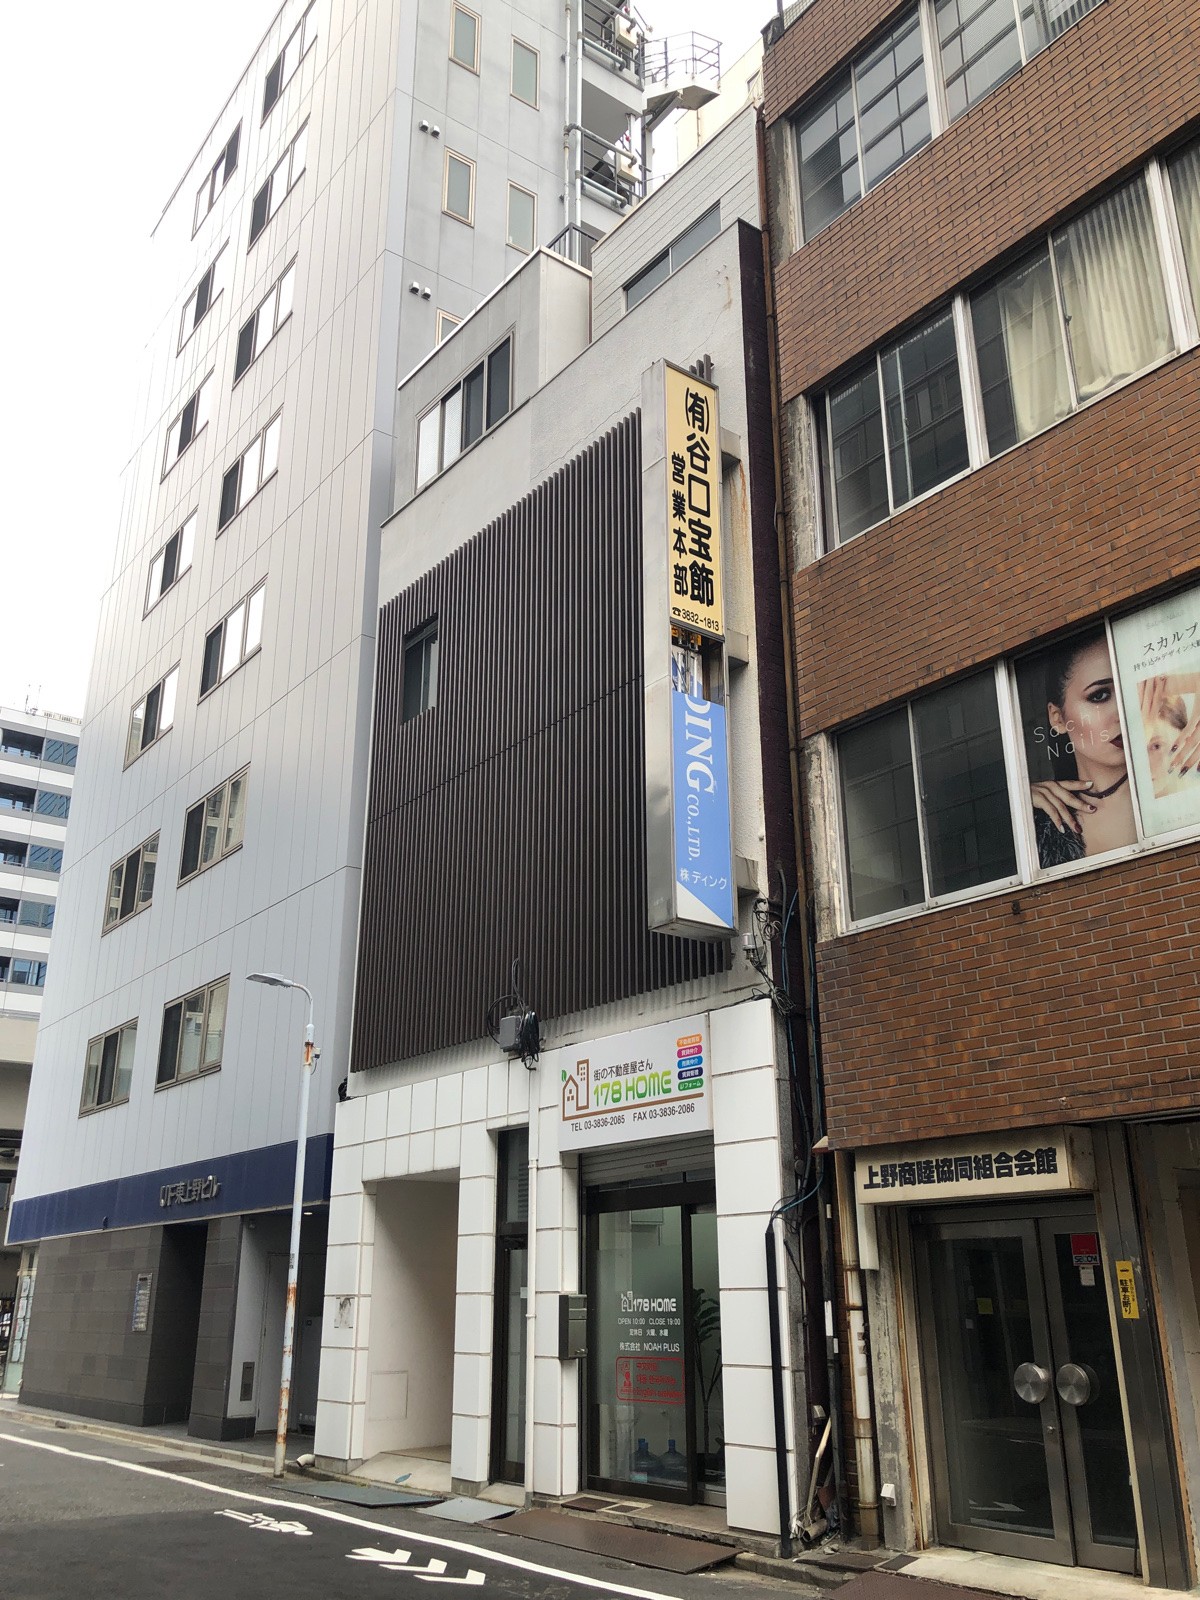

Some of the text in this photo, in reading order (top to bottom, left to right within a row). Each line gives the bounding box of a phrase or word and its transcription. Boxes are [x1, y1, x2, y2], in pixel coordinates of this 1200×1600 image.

[672, 451, 689, 597] 営業本部
[681, 608, 720, 632] 3832-1813
[1047, 729, 1110, 761] Nails
[593, 1058, 654, 1082] 街の不動産屋さん
[593, 1070, 672, 1107] 178 HOME
[571, 1102, 695, 1132] TEL 03-3836-2085 FAX 03-3836-2086
[633, 1297, 677, 1312] 178 HOME
[619, 1342, 680, 1352] 株式会社 NOAH PLUS
